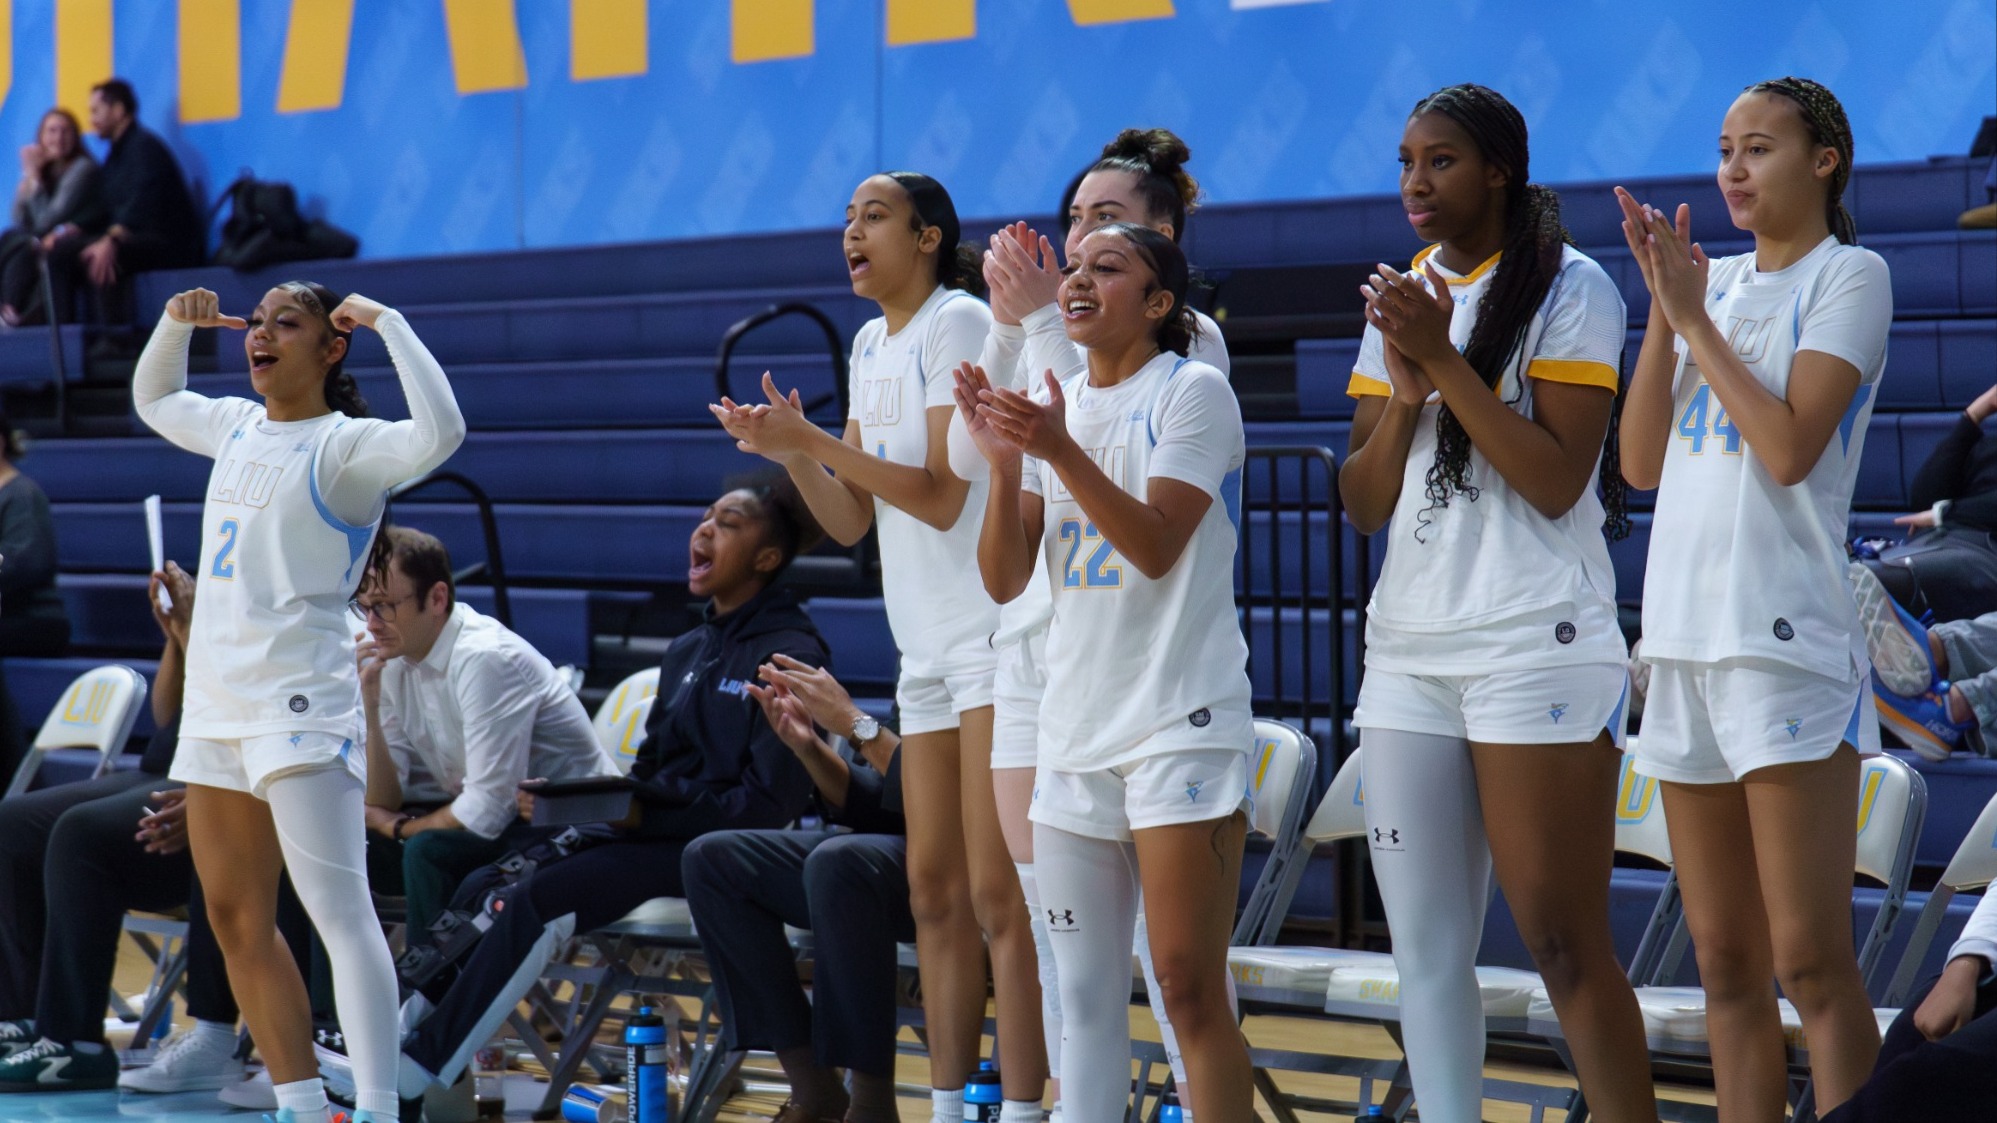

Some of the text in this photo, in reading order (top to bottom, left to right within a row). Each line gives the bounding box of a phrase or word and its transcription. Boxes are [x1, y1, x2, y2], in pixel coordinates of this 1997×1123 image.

[863, 376, 902, 427] LIU
[1674, 381, 1744, 456] 44
[211, 459, 285, 510] LIU
[209, 516, 242, 582] 2
[1058, 517, 1123, 590] 22
[61, 678, 119, 726] LIU
[627, 1044, 637, 1123] POWERADE
